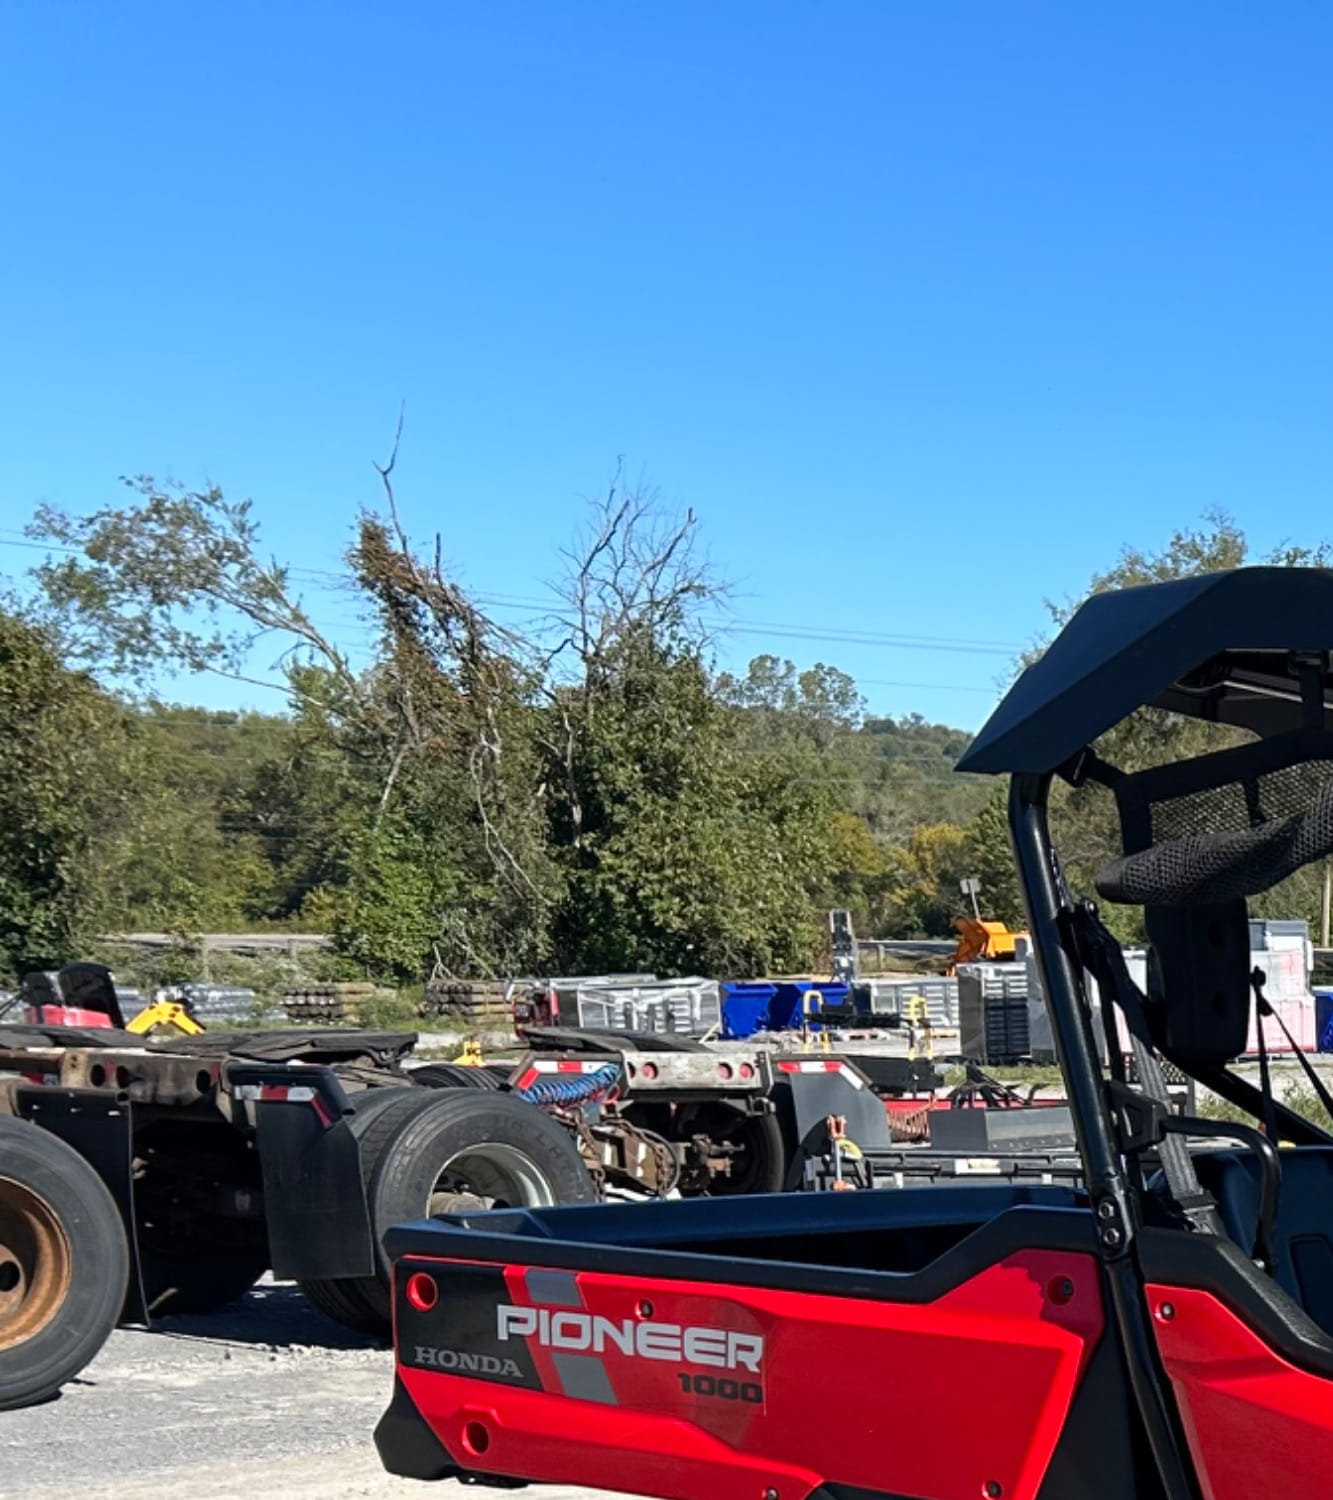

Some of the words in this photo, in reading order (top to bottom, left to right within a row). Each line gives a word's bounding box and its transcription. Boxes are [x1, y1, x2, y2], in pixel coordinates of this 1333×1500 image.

[497, 1304, 763, 1373] PIONEER
[414, 1345, 524, 1378] HONDA
[677, 1372, 763, 1404] 1000
